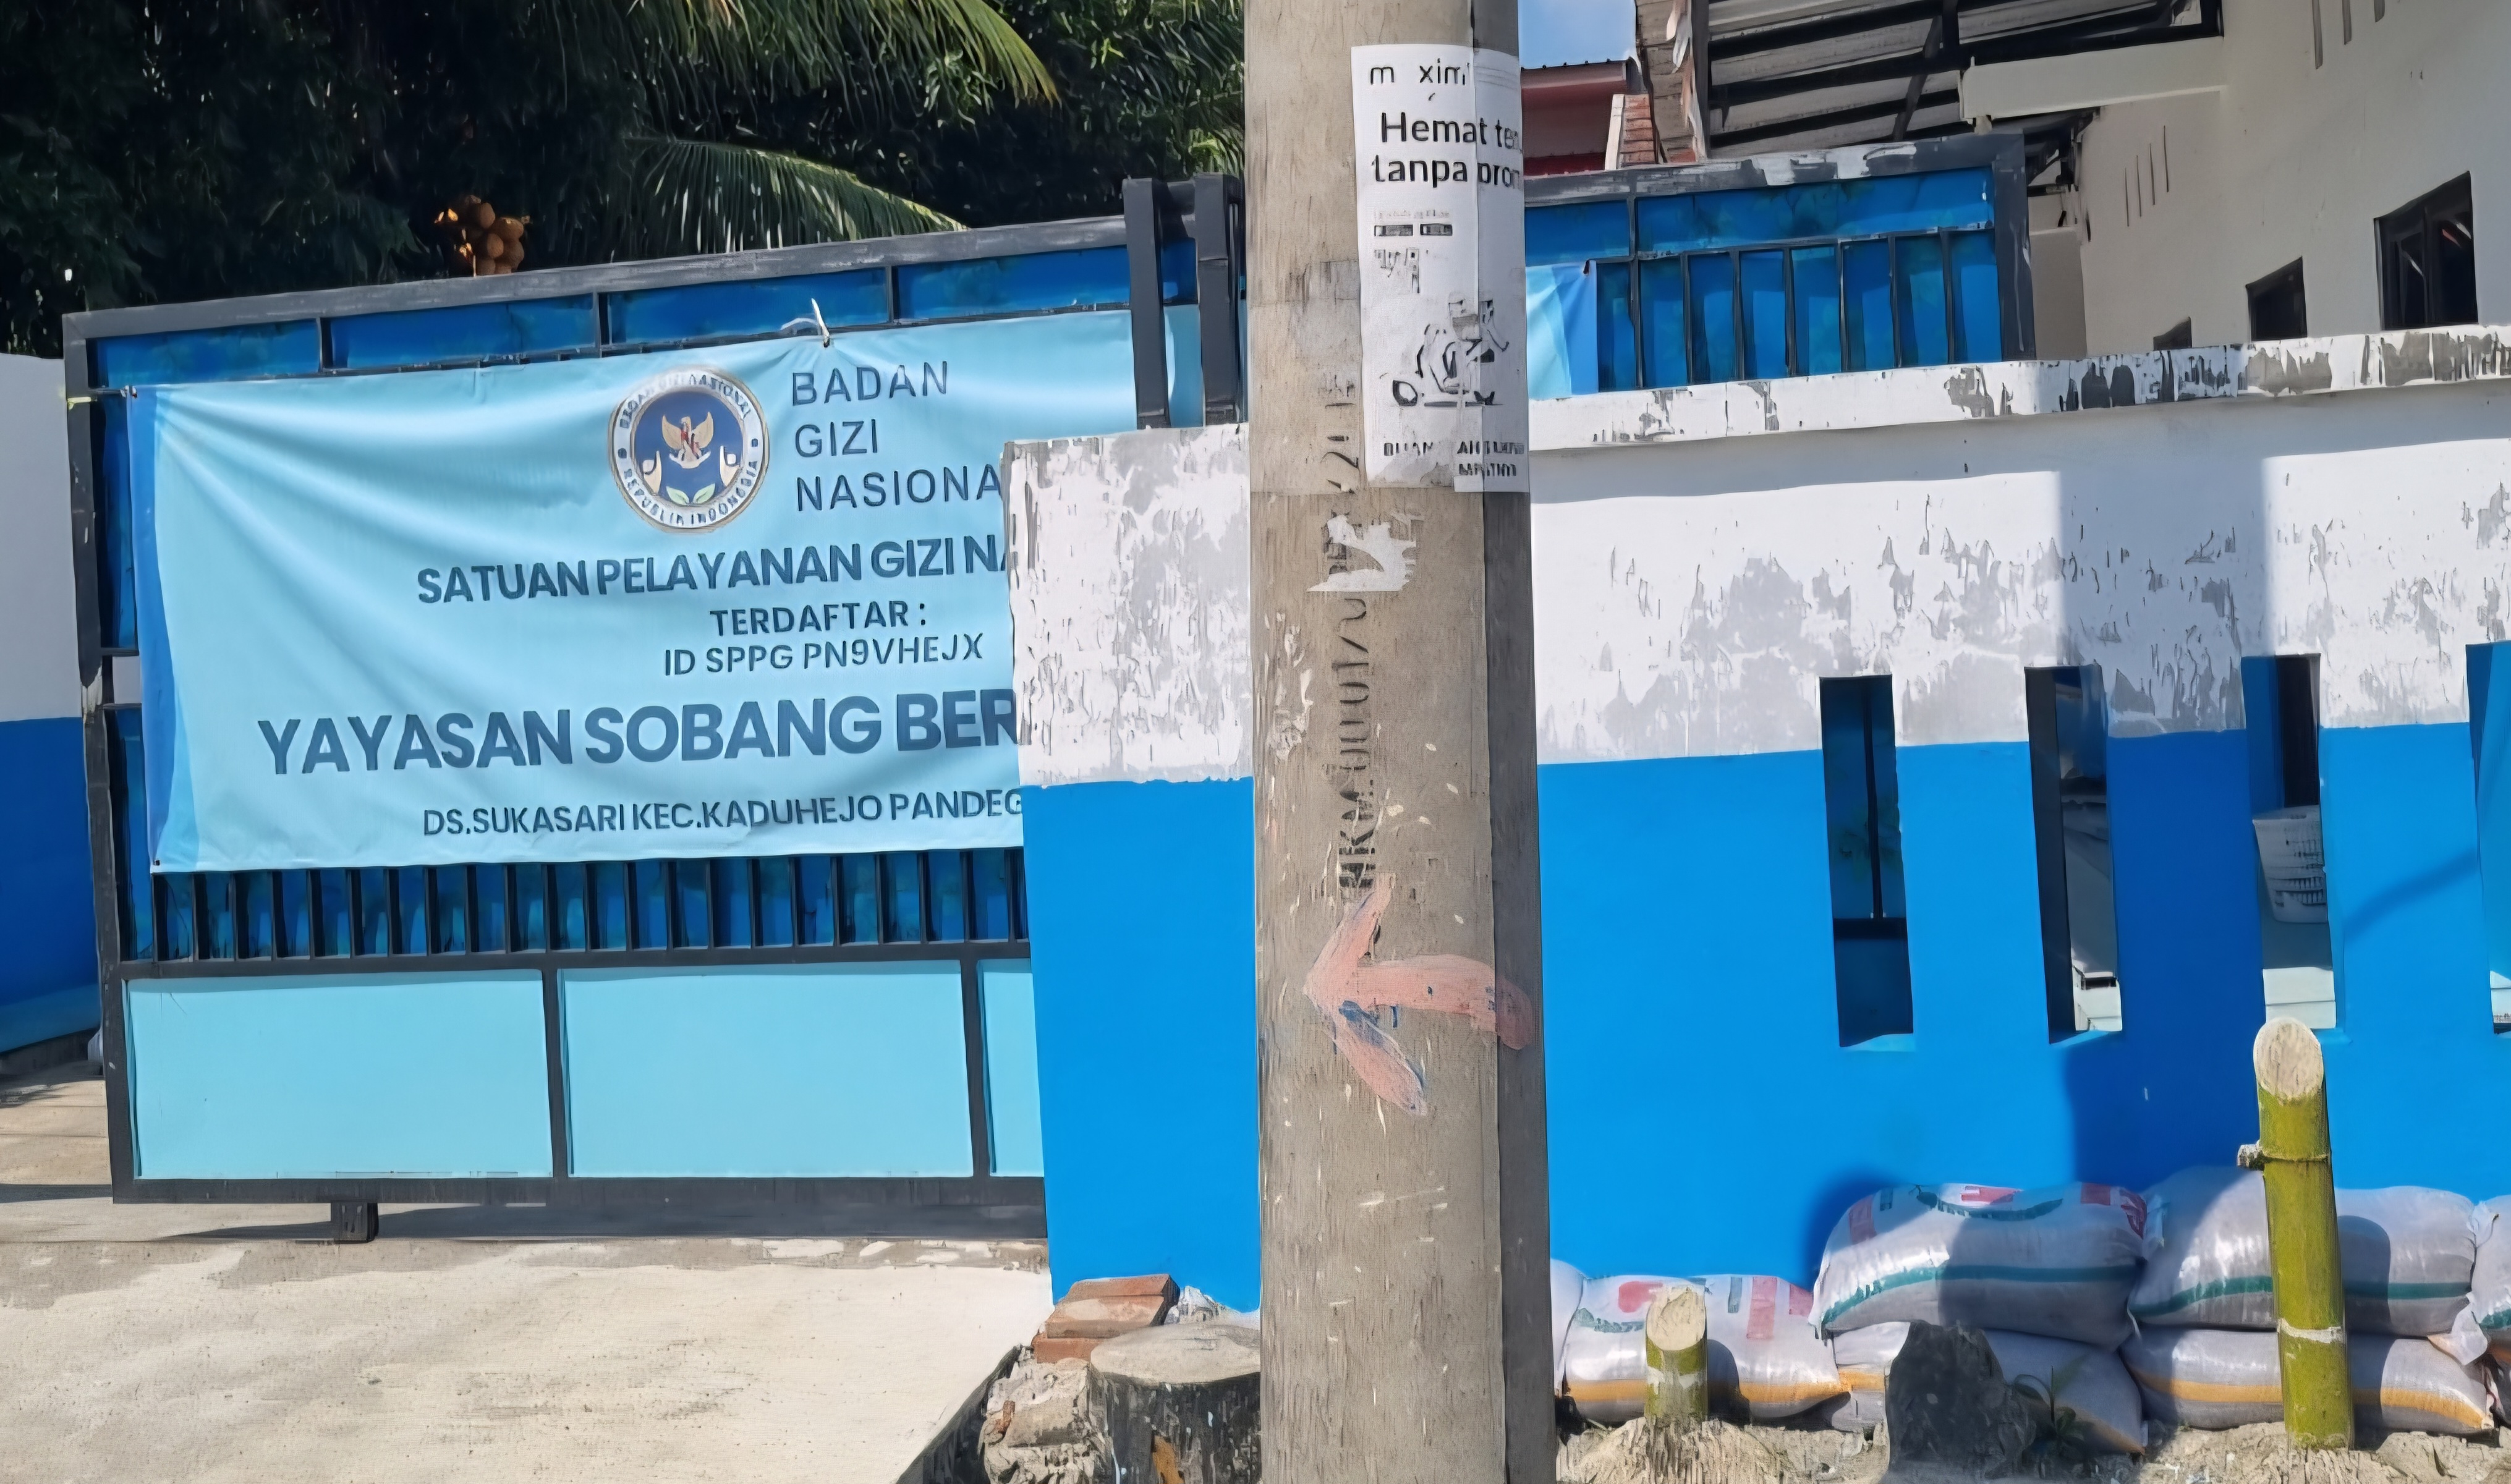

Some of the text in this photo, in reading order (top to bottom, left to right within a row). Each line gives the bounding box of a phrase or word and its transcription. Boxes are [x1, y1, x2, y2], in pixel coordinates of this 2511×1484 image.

[1382, 112, 1487, 145] Hemat
[792, 361, 948, 406] BADAN
[796, 419, 878, 457] GIZI
[418, 560, 590, 603] SATUAN
[597, 543, 862, 596] PELAYANAN
[871, 537, 954, 578] GIZI
[710, 600, 909, 637] TERDAFTAR
[665, 633, 984, 676] ID SPPG PN9VHEJX
[257, 709, 573, 775] YAYASAN
[585, 695, 882, 764] SOBANG
